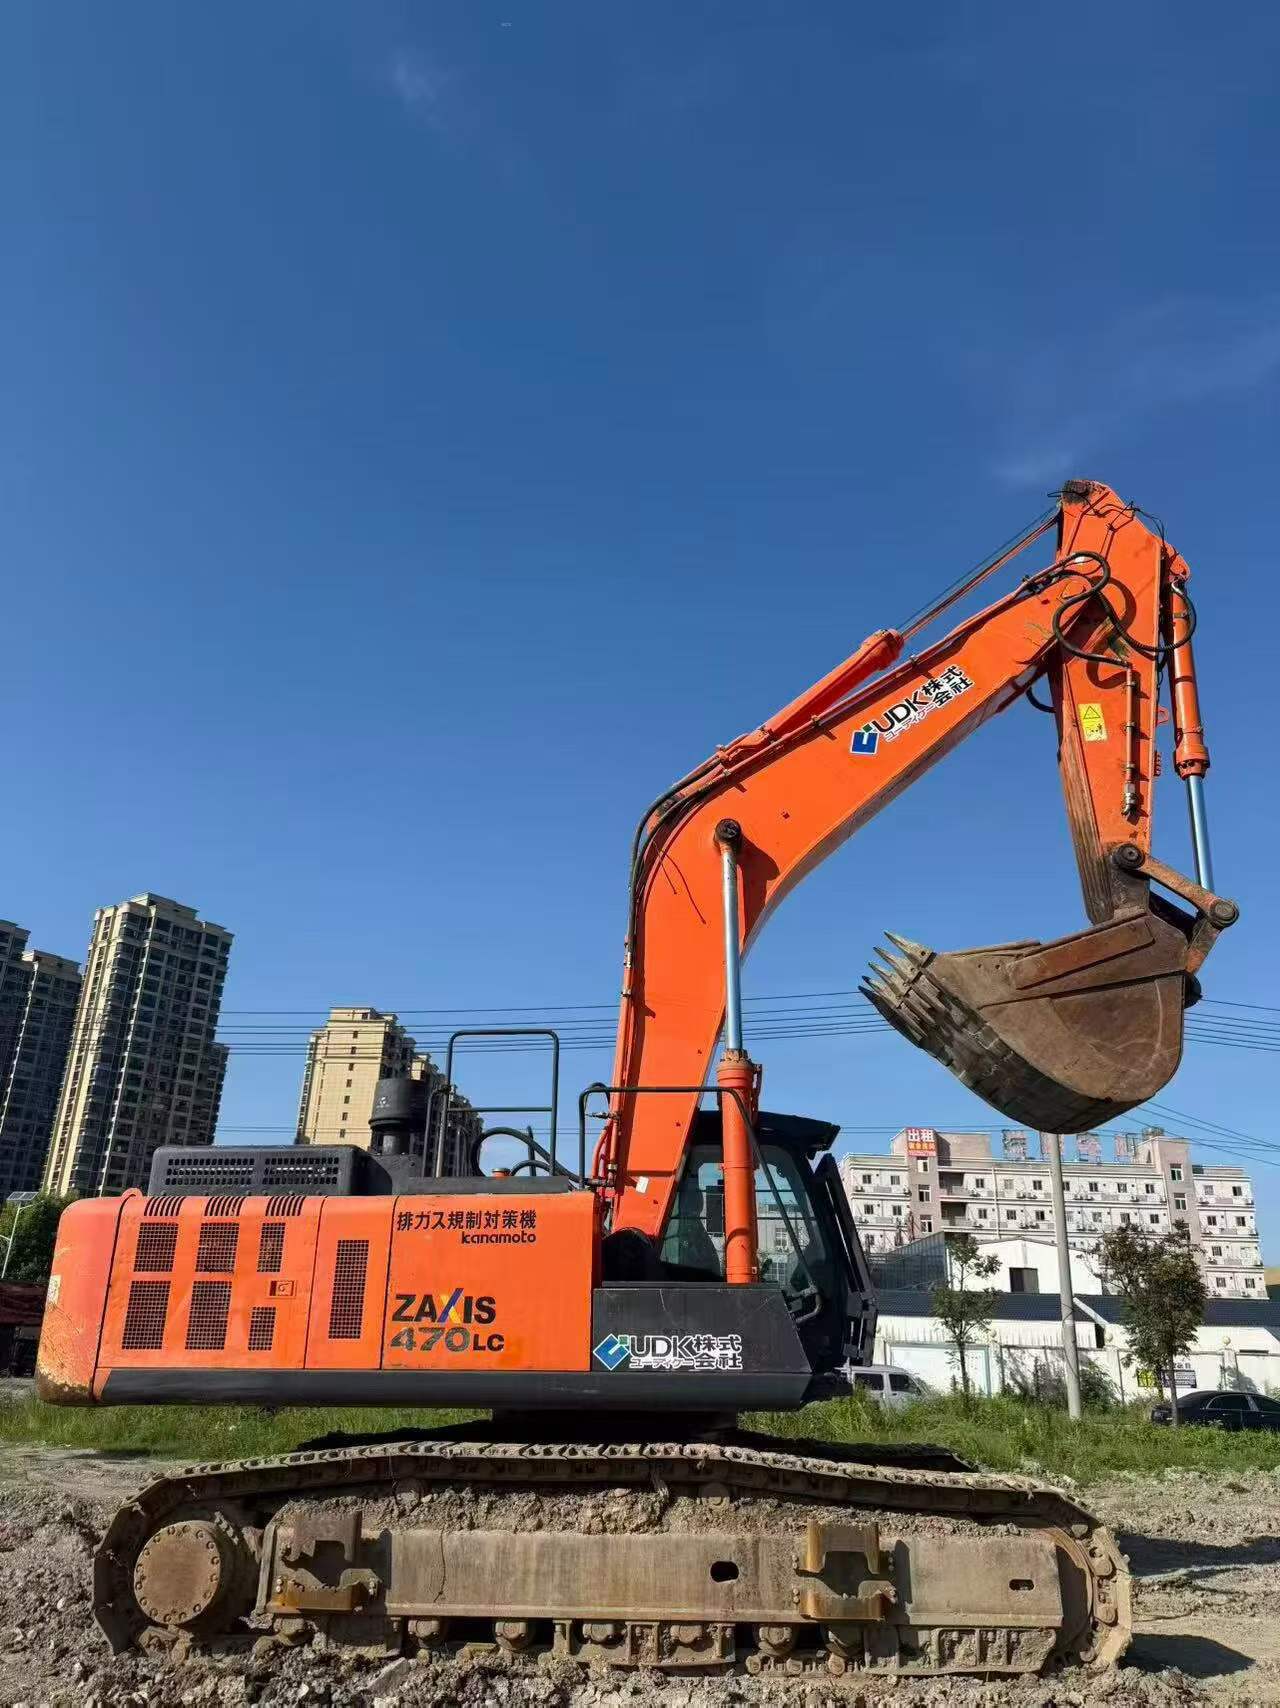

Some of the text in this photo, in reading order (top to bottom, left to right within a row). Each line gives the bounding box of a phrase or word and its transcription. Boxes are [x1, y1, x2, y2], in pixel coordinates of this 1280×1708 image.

[871, 690, 928, 733] UDK
[397, 1210, 537, 1231] 排ガス規制対策機
[461, 1231, 537, 1244] kanamoto
[392, 1287, 496, 1324] ZAXIS
[629, 1335, 696, 1358] UDK
